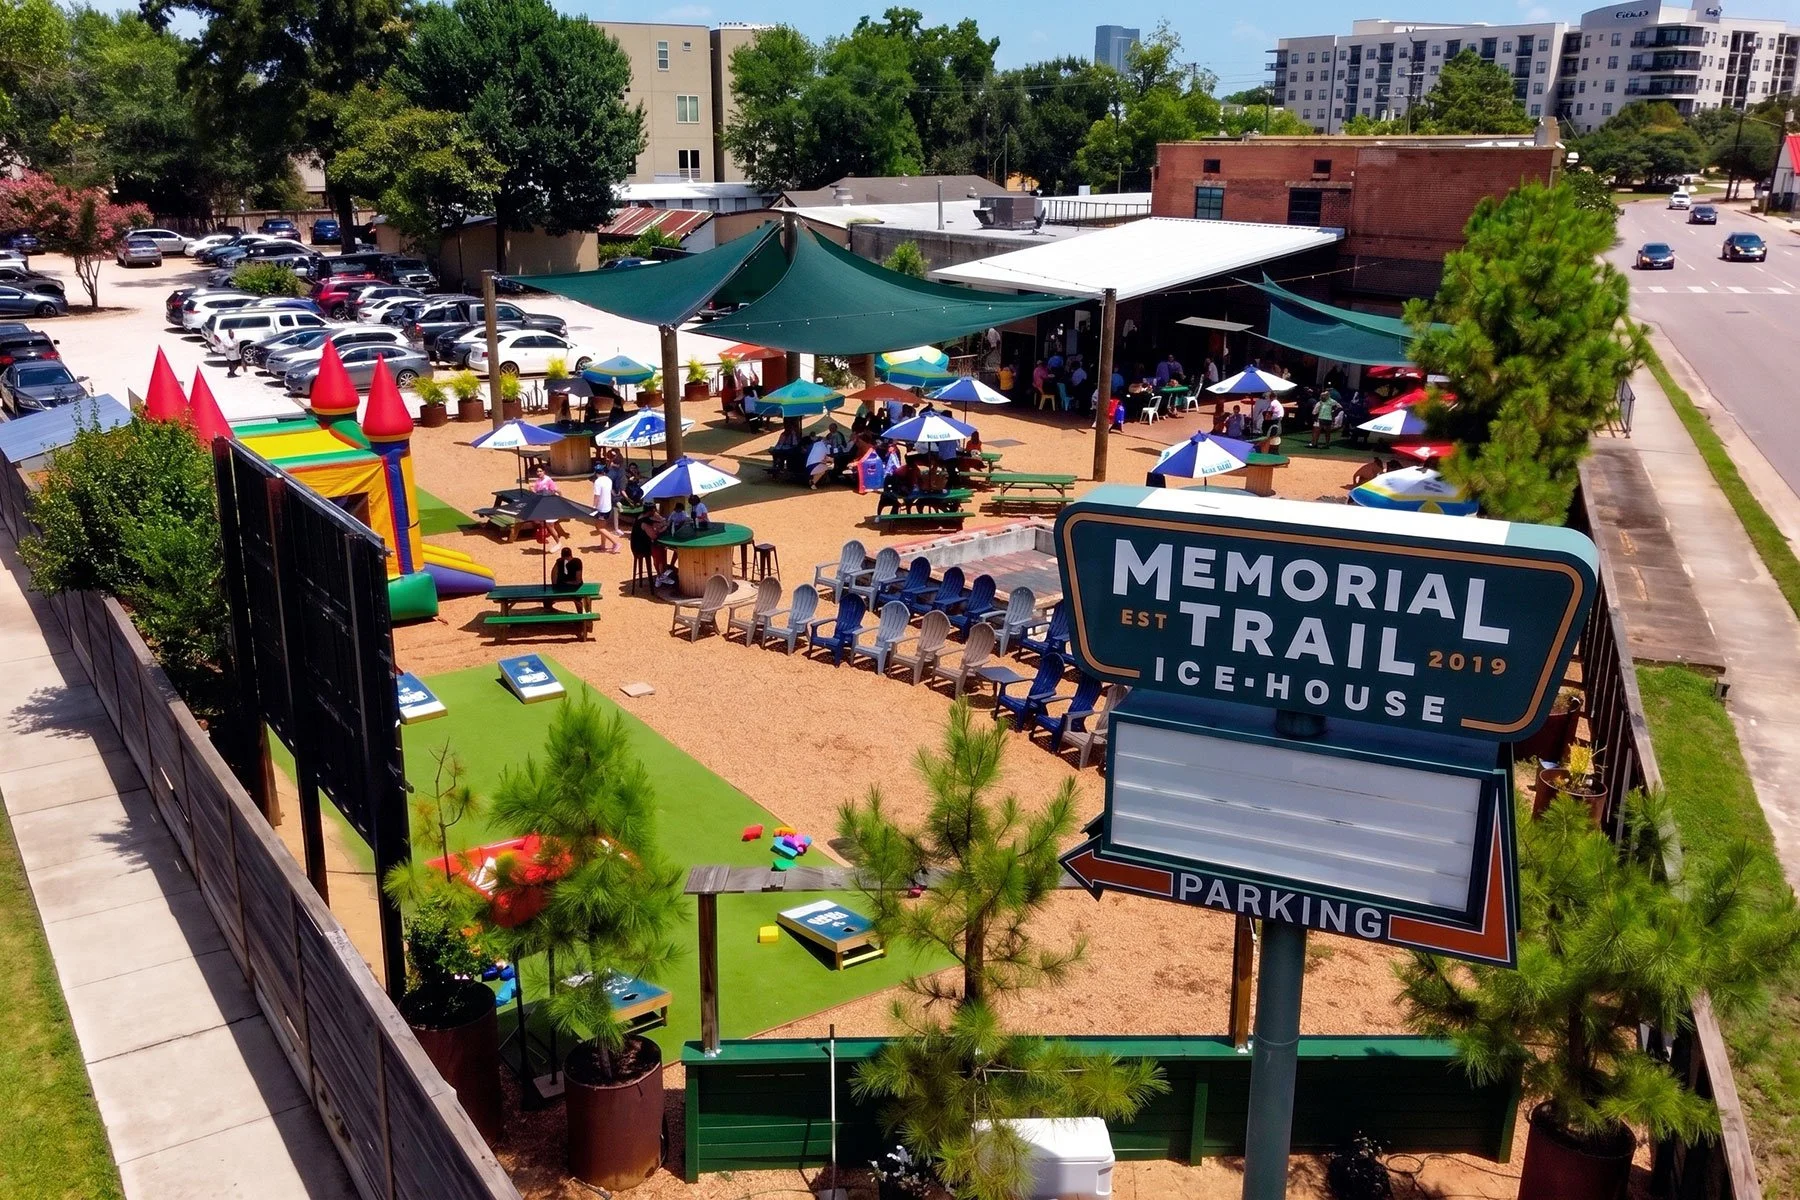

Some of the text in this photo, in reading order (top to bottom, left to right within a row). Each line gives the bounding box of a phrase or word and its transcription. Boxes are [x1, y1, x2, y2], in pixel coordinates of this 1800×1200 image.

[1112, 538, 1510, 645] MEMORIAL
[1120, 608, 1168, 630] EST
[1179, 601, 1415, 676] TRAIL
[1428, 650, 1508, 676] 2019
[1179, 872, 1382, 939] PARKING
